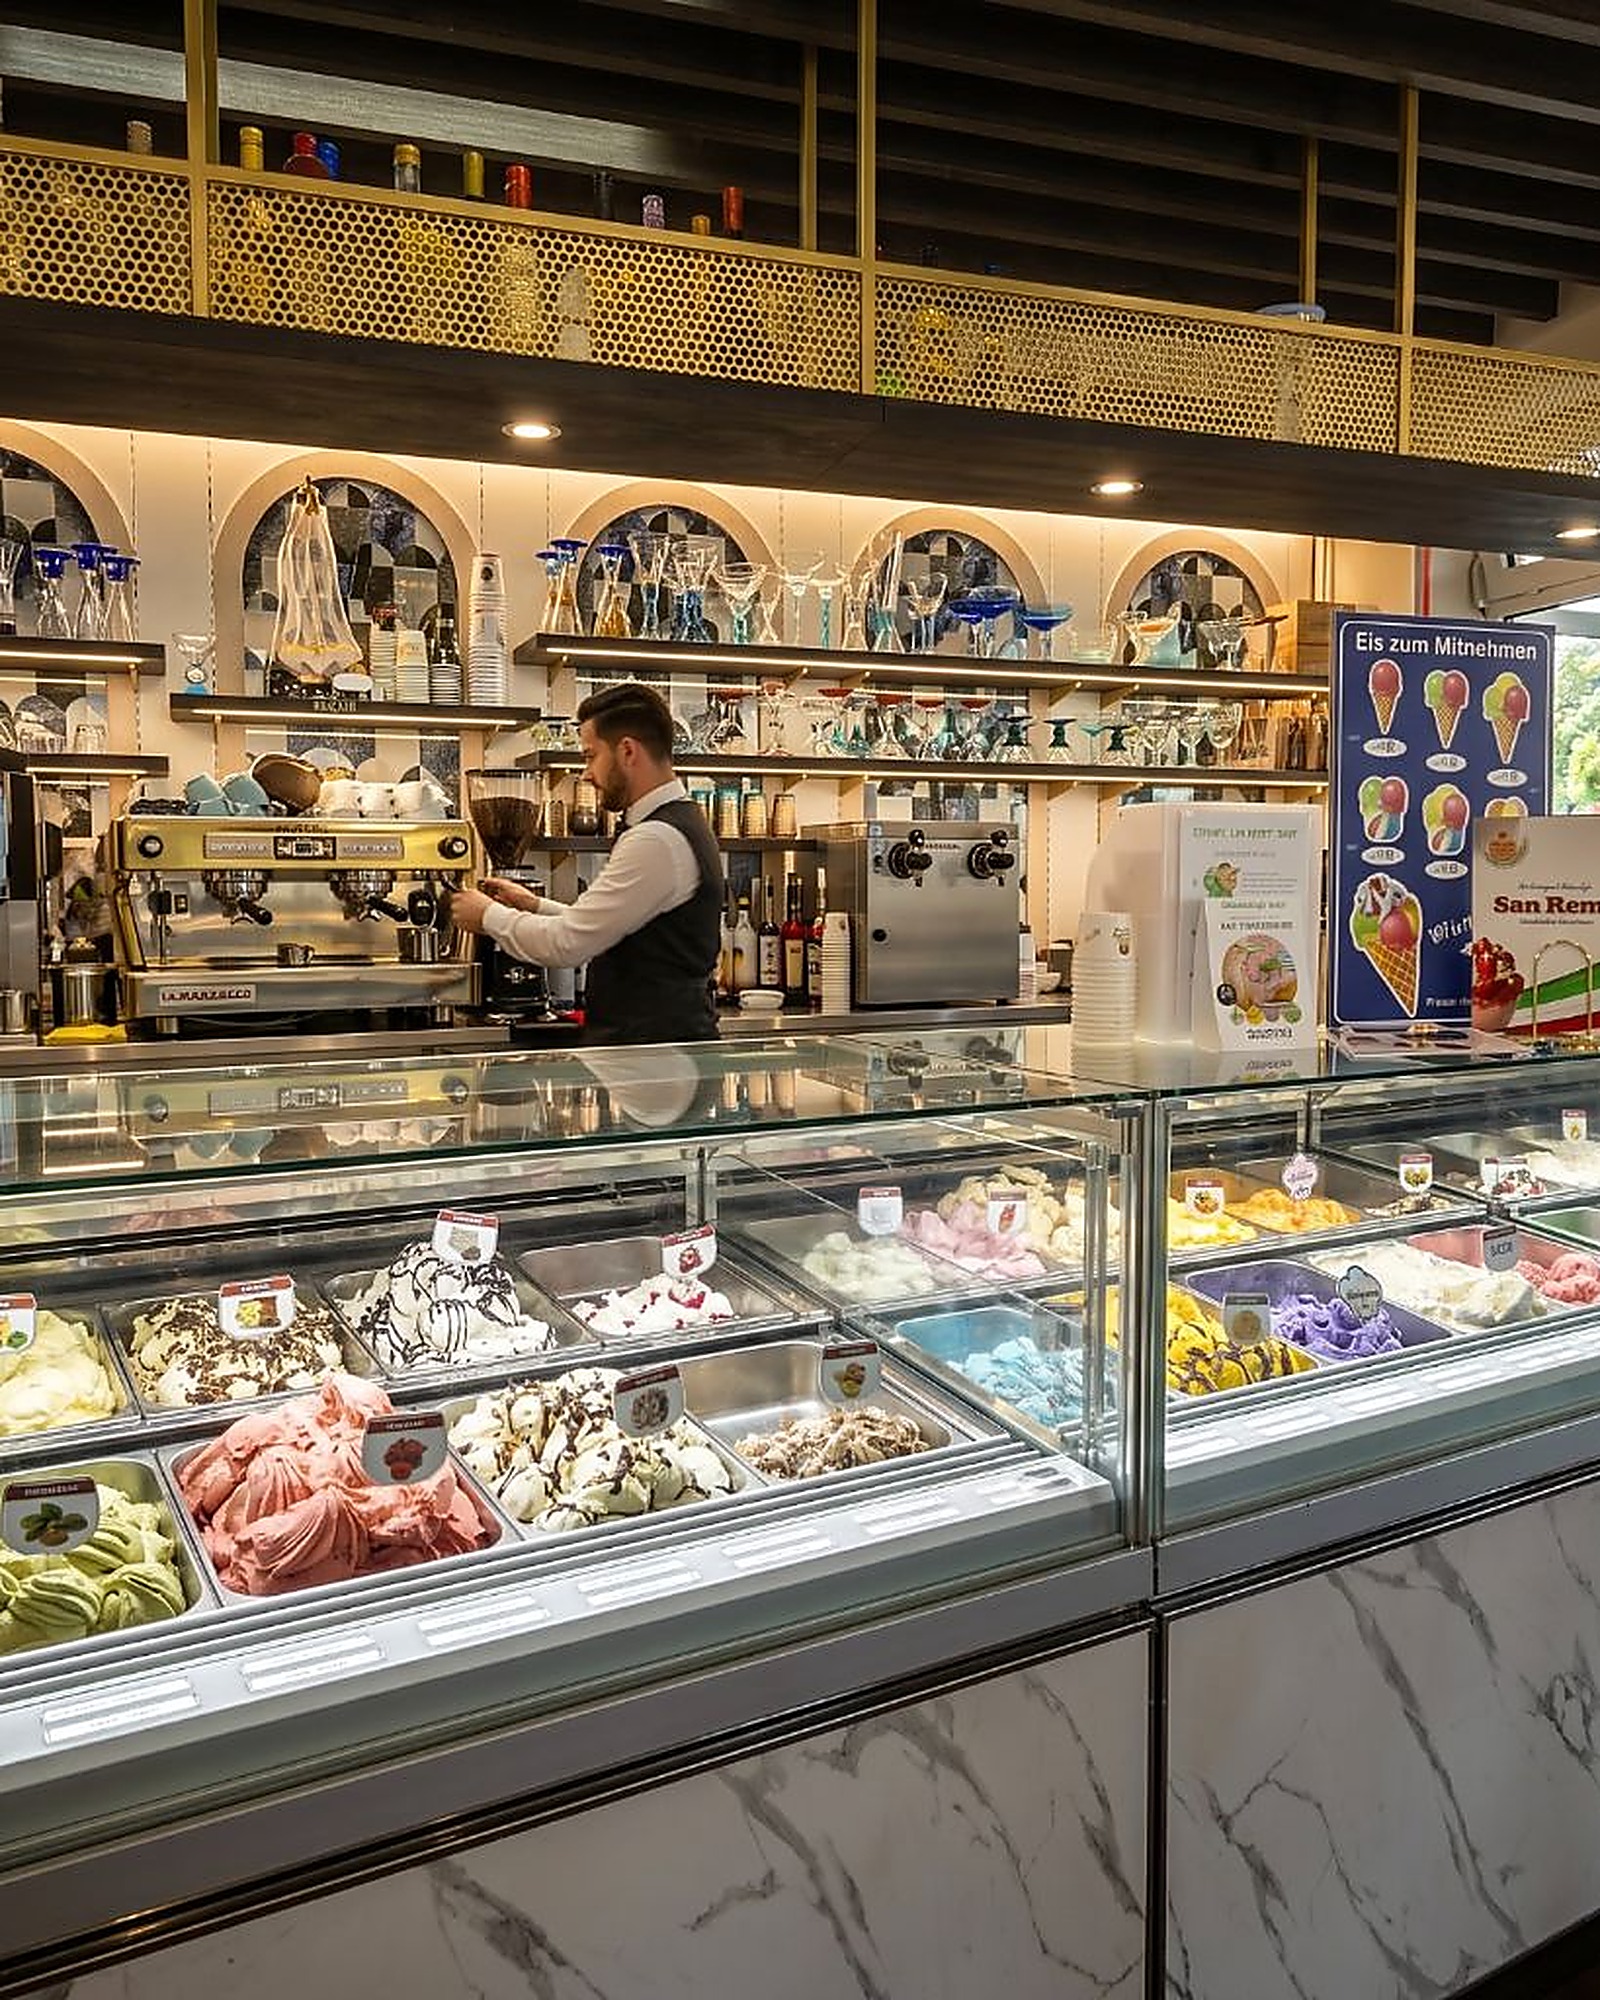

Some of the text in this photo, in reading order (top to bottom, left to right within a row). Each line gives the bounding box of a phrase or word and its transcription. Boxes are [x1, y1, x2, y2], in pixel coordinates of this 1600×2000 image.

[1356, 631, 1537, 661] Eis zum Mitnehmen
[1493, 896, 1541, 913] San
